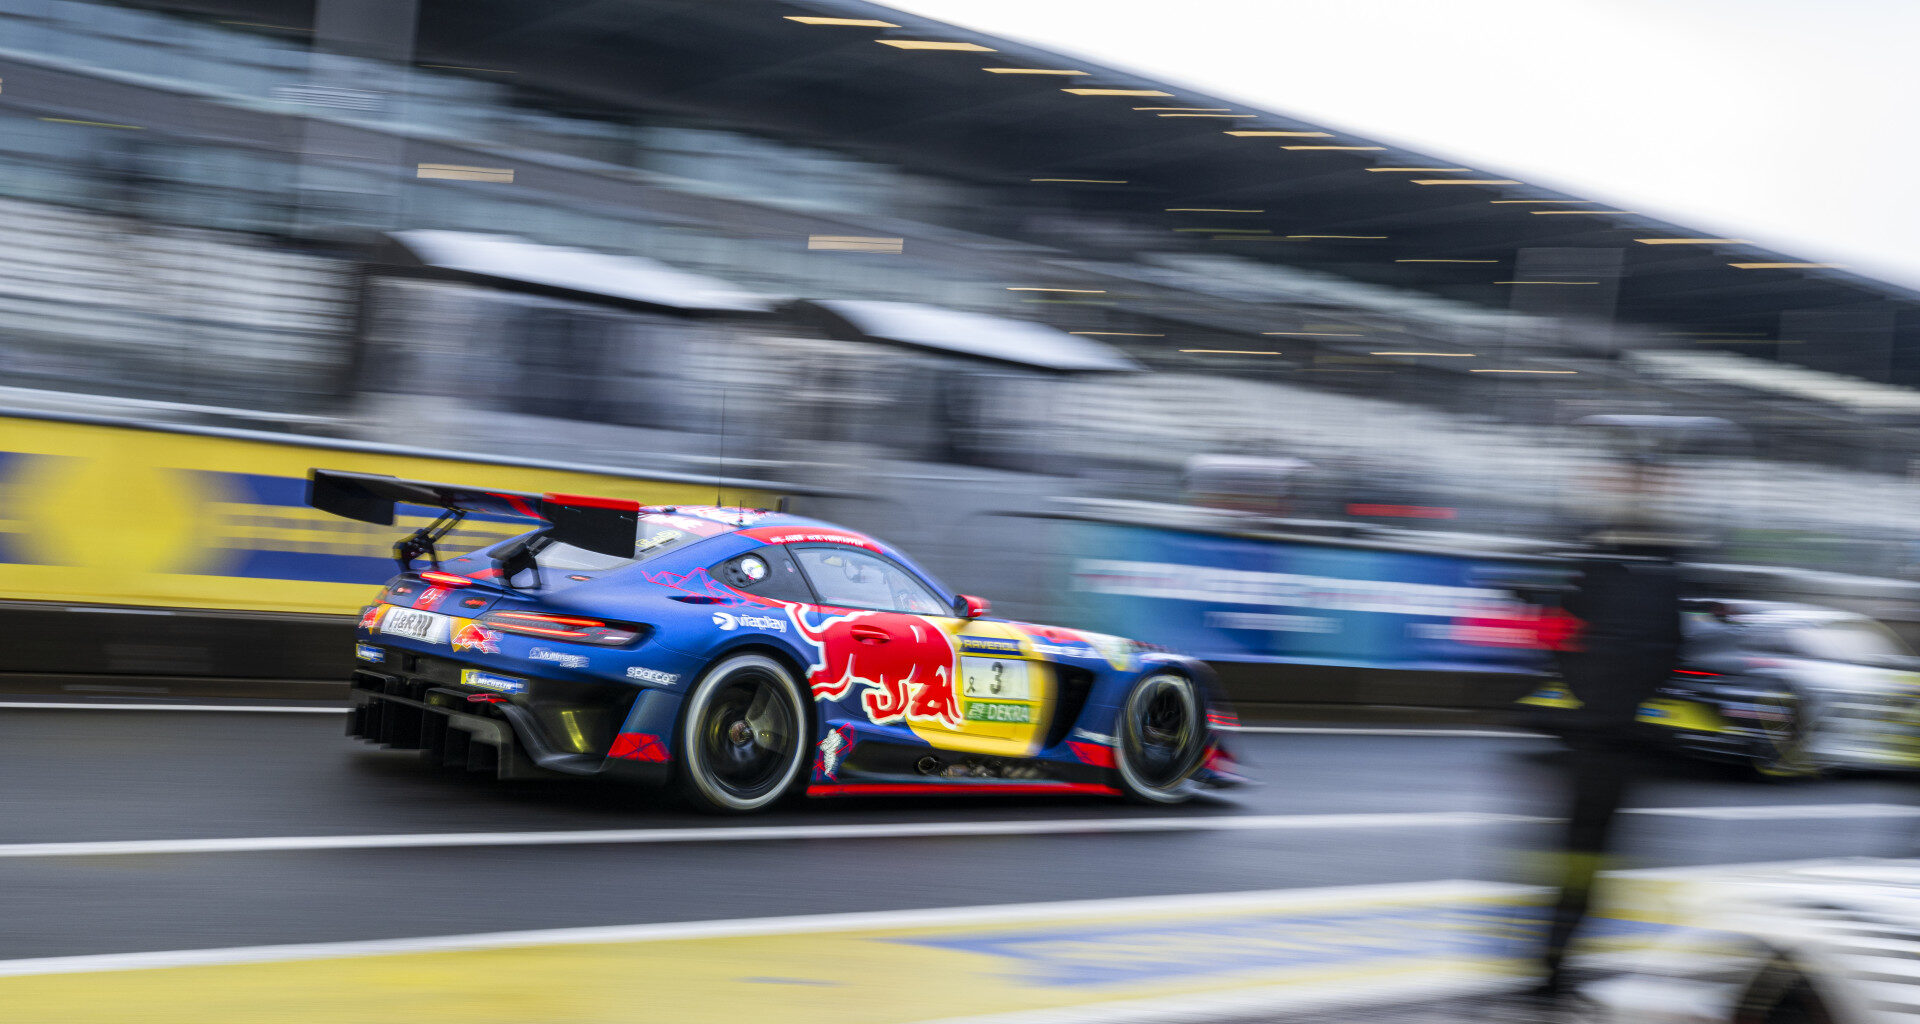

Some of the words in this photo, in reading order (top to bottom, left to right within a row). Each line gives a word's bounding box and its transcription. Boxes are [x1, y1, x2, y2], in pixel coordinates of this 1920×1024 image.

[735, 614, 787, 633] viaplay
[626, 666, 672, 683] sparco
[989, 661, 1005, 694] 3
[987, 703, 1030, 721] DEKRA
